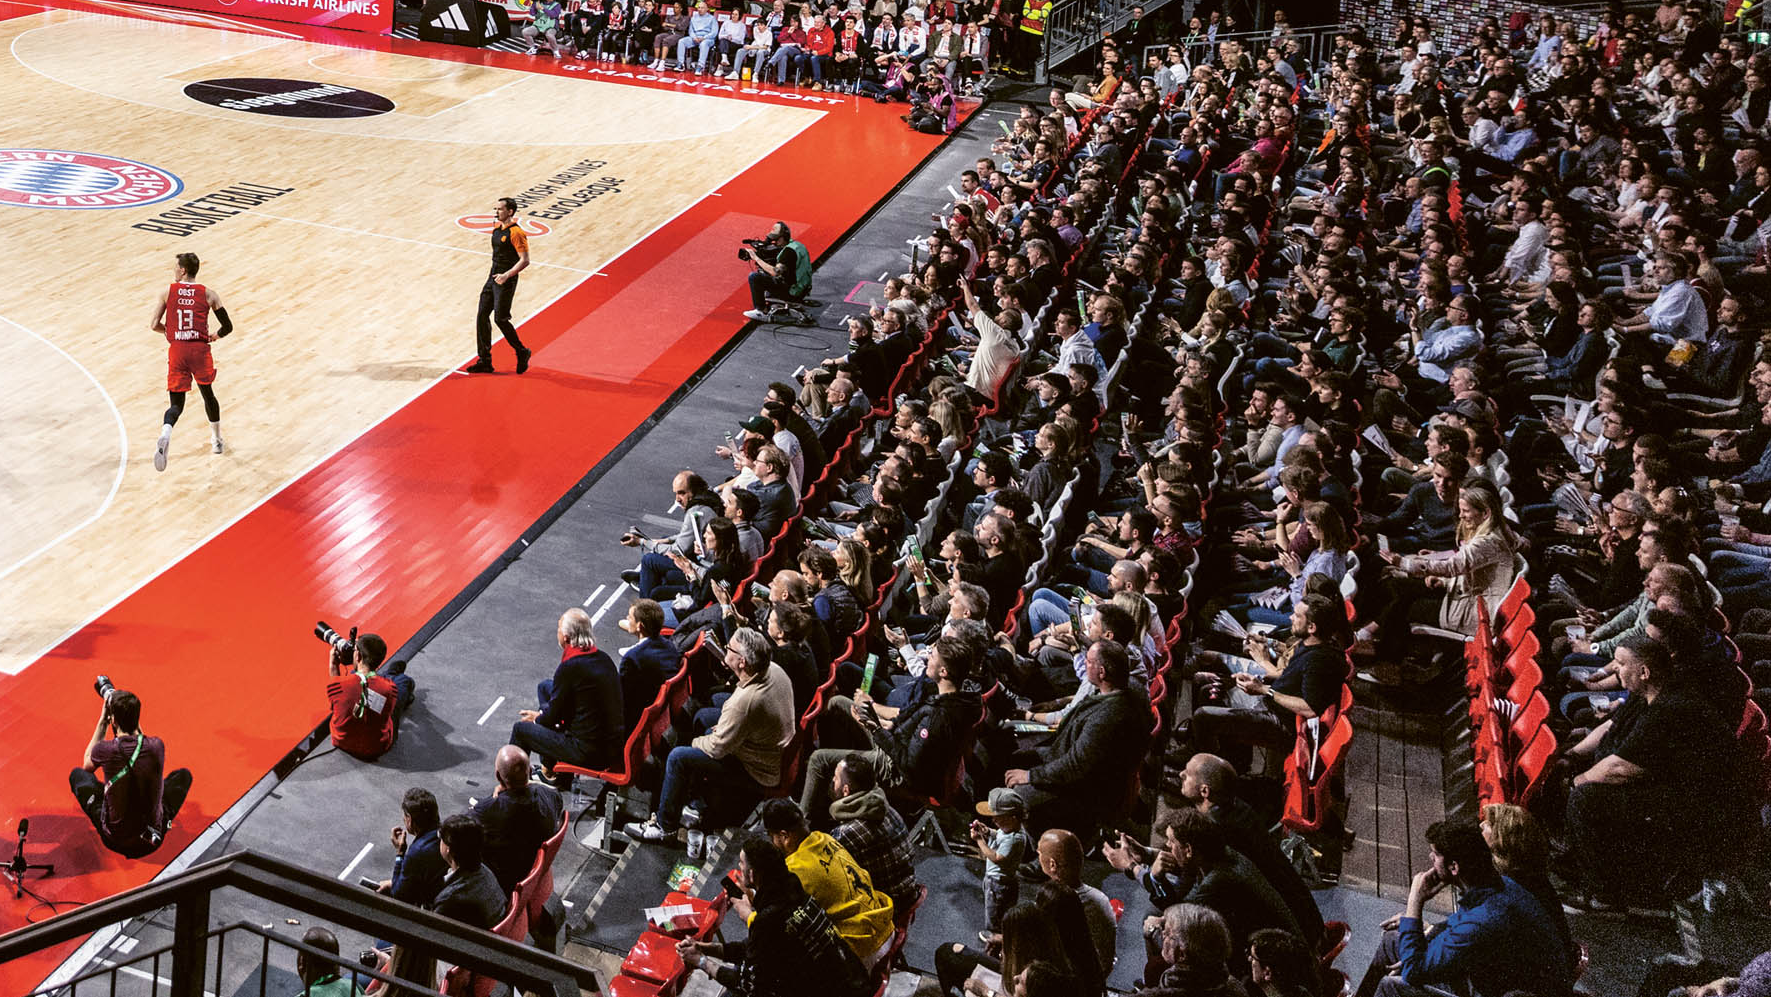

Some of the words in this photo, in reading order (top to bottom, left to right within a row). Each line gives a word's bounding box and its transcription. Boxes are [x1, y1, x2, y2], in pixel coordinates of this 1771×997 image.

[219, 84, 356, 110] siegmund
[588, 68, 734, 92] MAGENTA
[739, 86, 846, 106] SPORT
[29, 165, 164, 205] MÜNCHEN
[515, 182, 555, 213] URKISH
[556, 158, 608, 187] AIRLINES
[528, 175, 625, 221] EuroLeague
[132, 182, 295, 237] BASKETBALL
[175, 331, 199, 340] MUNICH
[177, 309, 193, 330] 13
